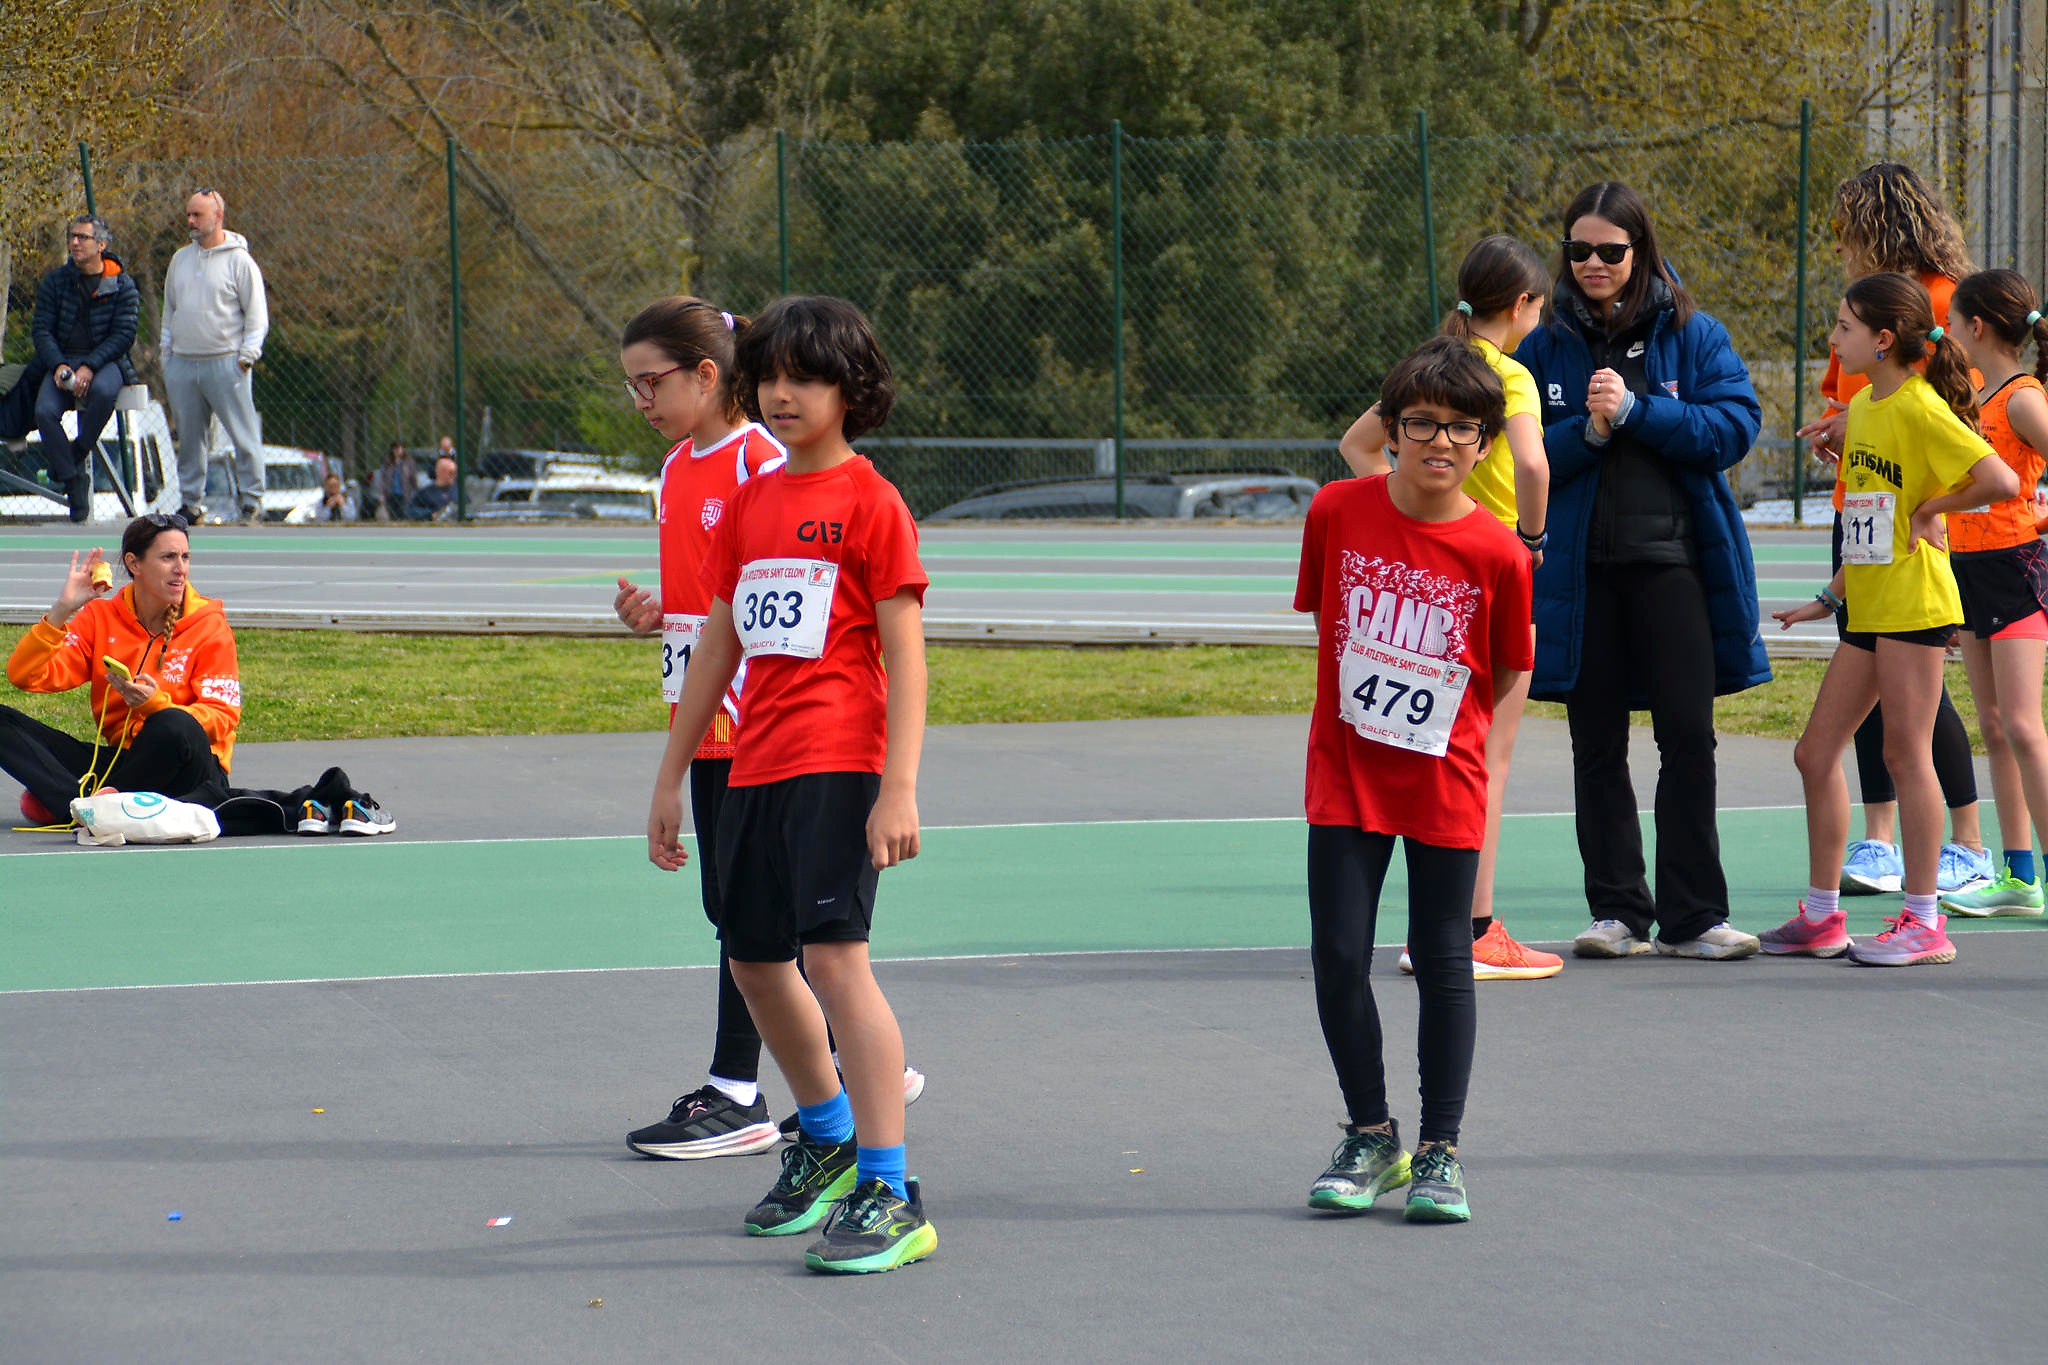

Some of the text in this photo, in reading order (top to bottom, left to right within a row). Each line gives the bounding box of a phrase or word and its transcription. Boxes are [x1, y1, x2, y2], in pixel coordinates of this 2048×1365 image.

[1848, 450, 1903, 489] LETISME
[770, 568, 784, 578] SANT
[785, 567, 806, 578] CELONI
[743, 590, 803, 632] 363
[1350, 641, 1441, 679] CLUB ATLETISME SANT CELONI
[1352, 673, 1435, 726] 479
